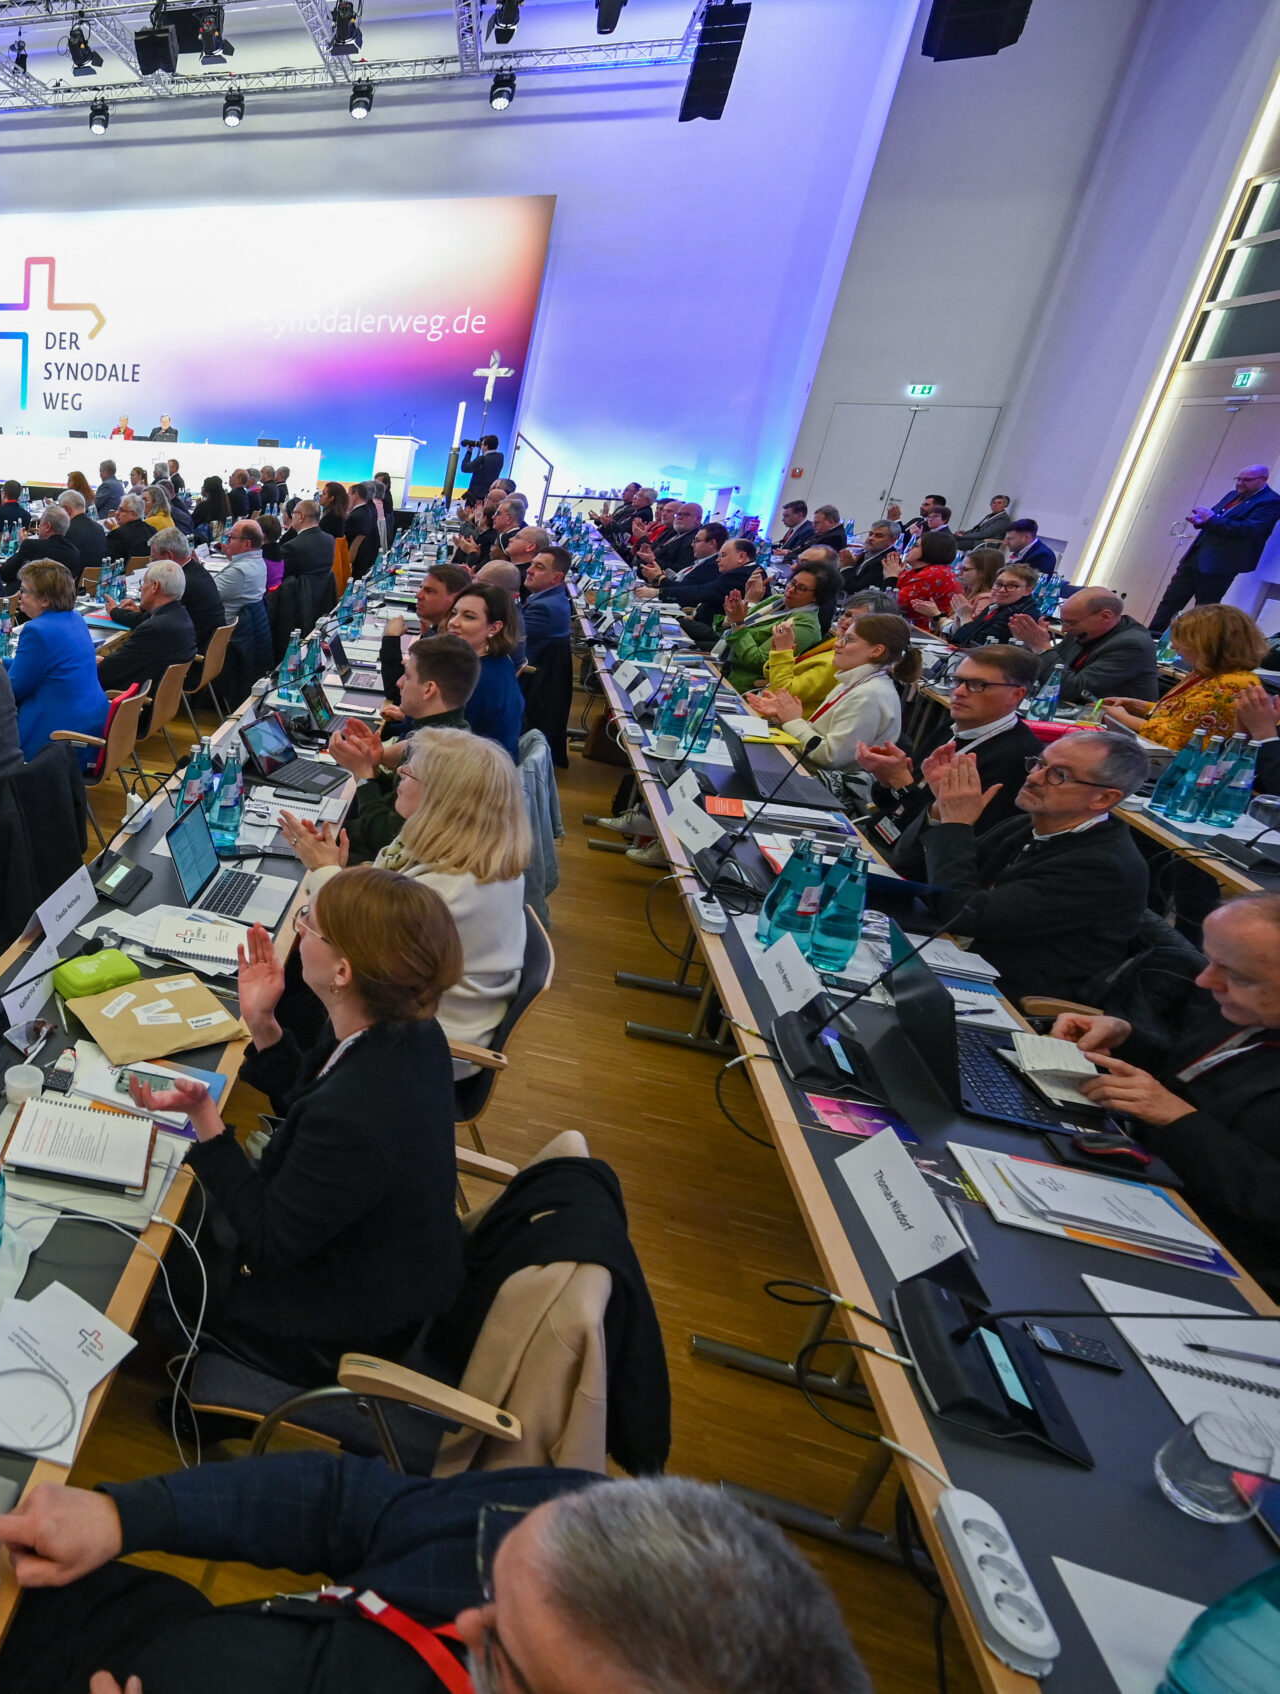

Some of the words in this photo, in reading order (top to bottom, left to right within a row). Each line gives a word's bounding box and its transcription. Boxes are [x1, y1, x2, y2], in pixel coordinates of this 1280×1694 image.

[261, 307, 487, 341] synodalerweg.de
[45, 331, 80, 350] DER
[43, 362, 141, 383] SYNODALE
[42, 392, 82, 411] WEG
[873, 1169, 894, 1201] Thomas
[890, 1199, 915, 1231] Nixdorf
